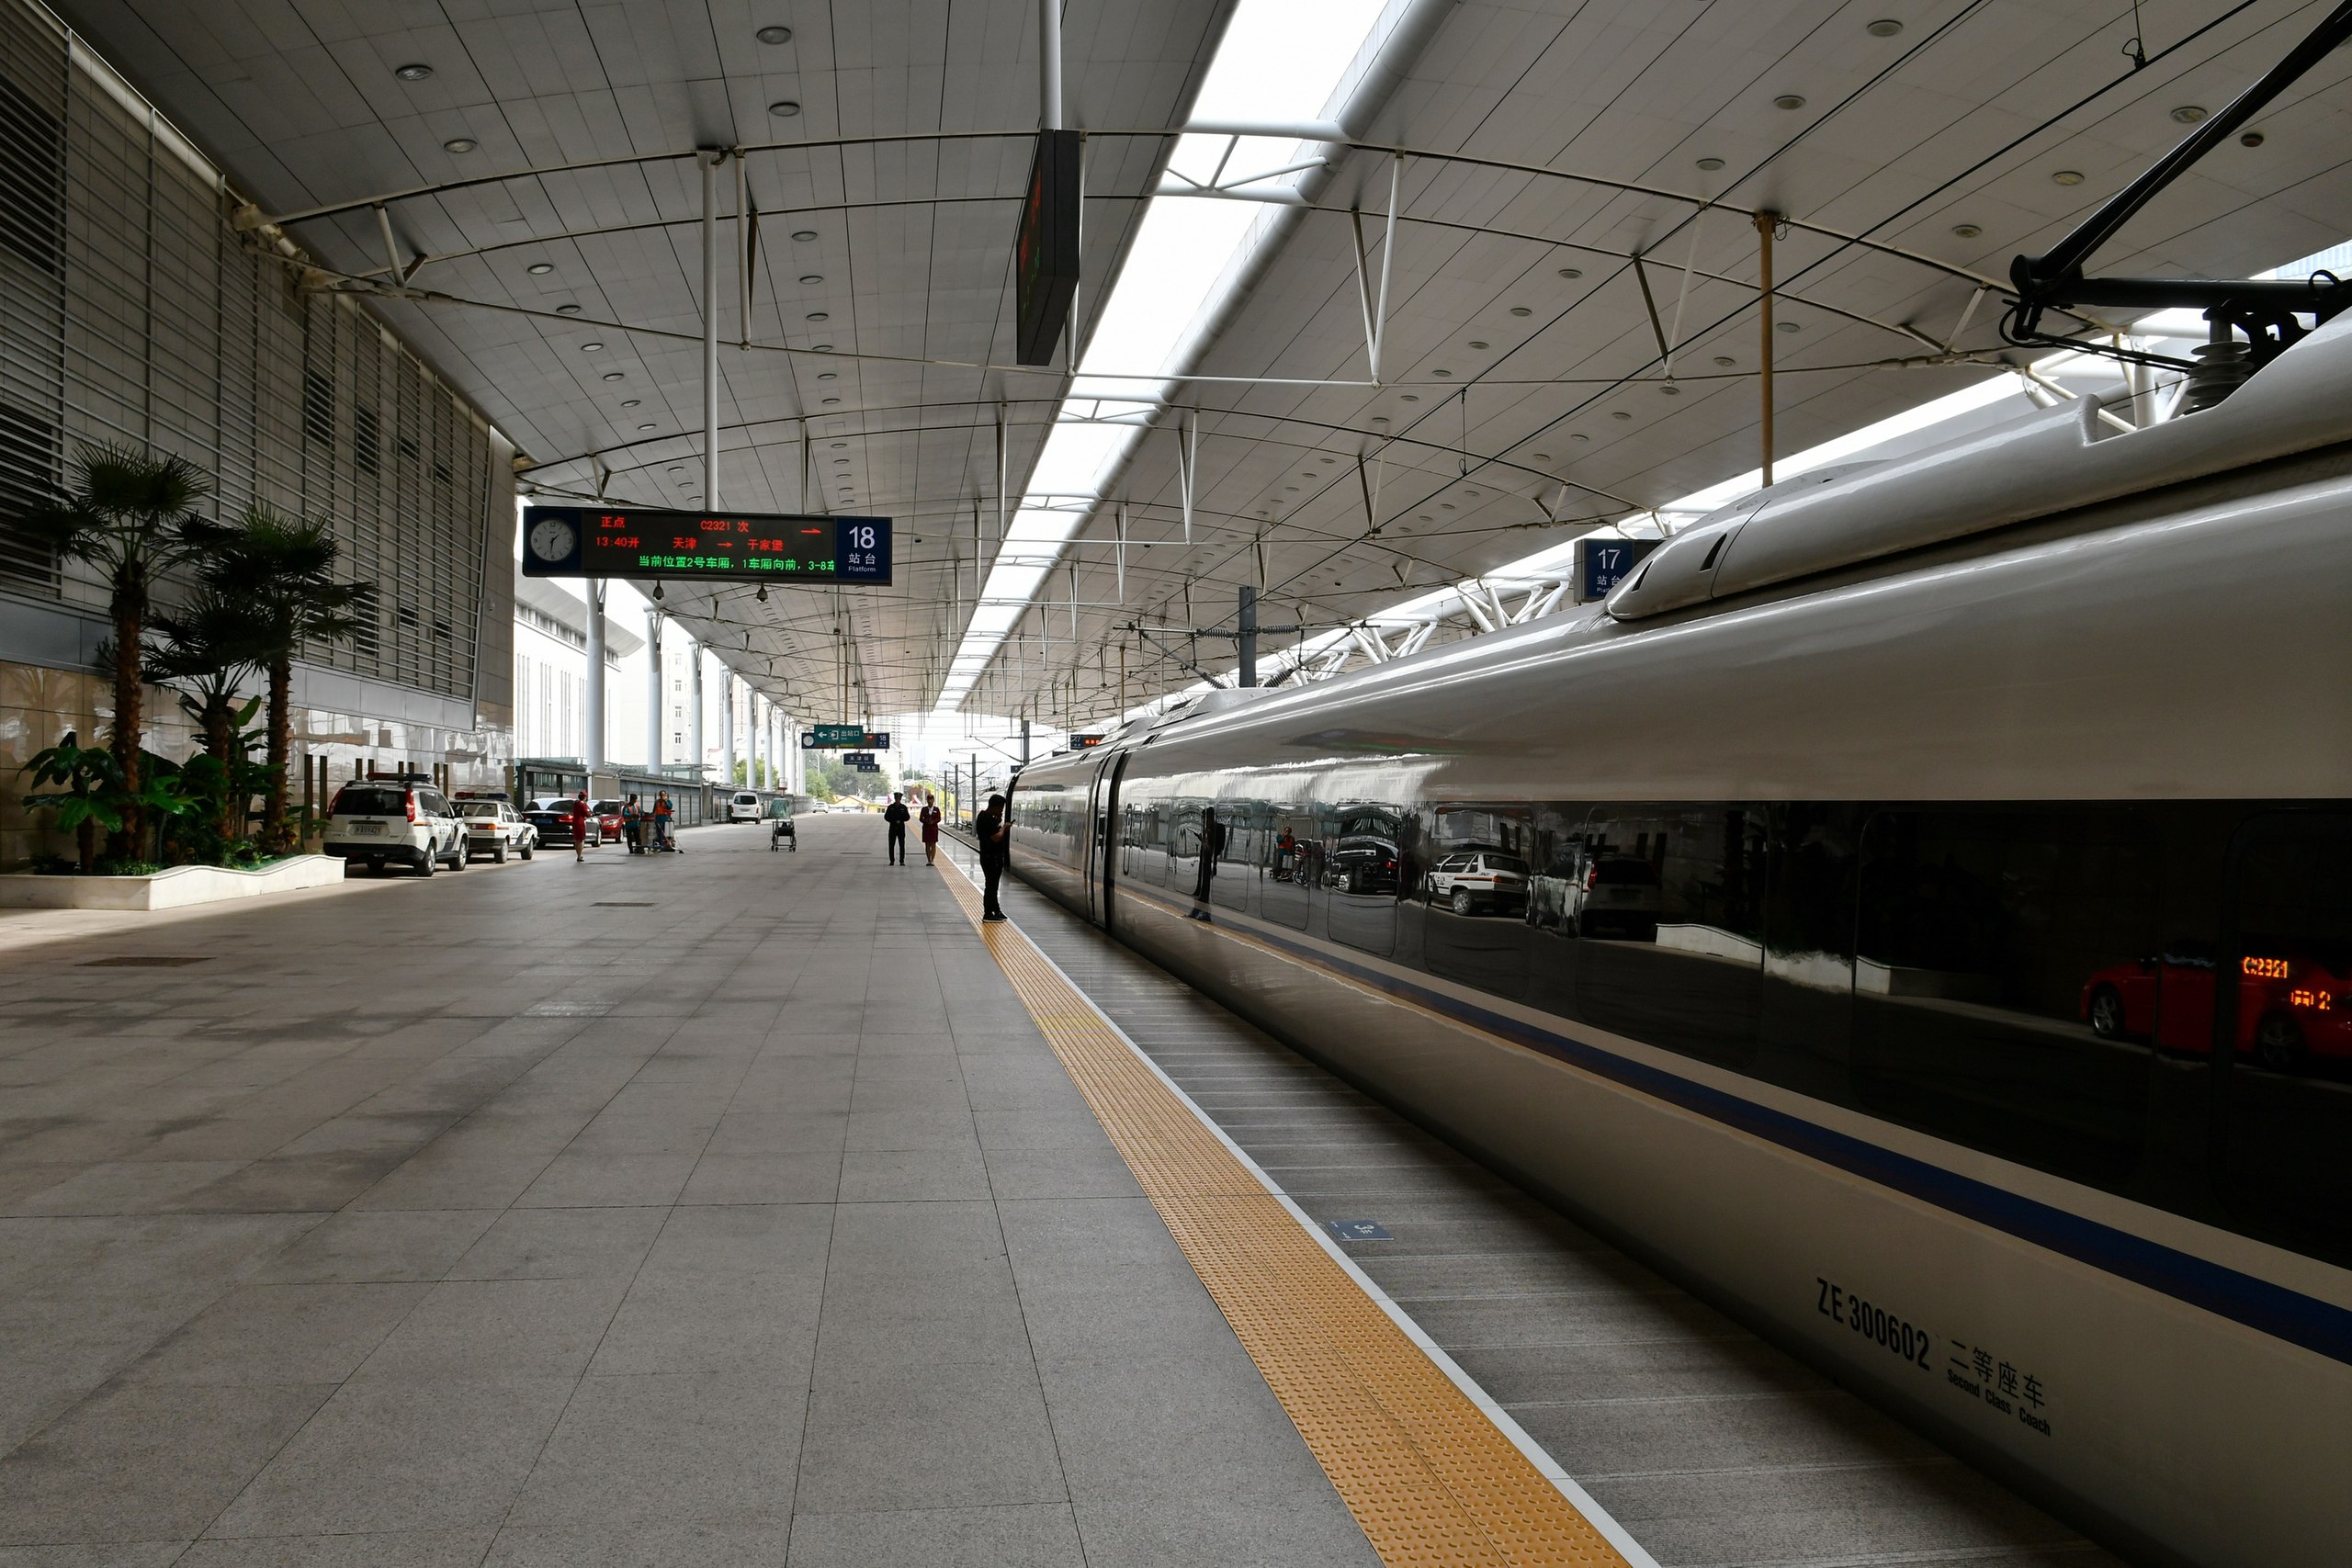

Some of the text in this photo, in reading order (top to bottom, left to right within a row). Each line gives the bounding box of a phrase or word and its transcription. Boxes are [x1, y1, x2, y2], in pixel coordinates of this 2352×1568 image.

[601, 516, 626, 528] 正点
[700, 520, 749, 533] C2321 次
[596, 536, 639, 548] 13:40开
[673, 537, 696, 549] 天津
[849, 525, 876, 549] 18
[848, 552, 876, 565] 站台
[1598, 548, 1621, 570] 17
[1817, 1277, 1930, 1371] ZE 300602
[1950, 1338, 2045, 1409] 二等座车
[1947, 1369, 2051, 1437] Second Class Coach
